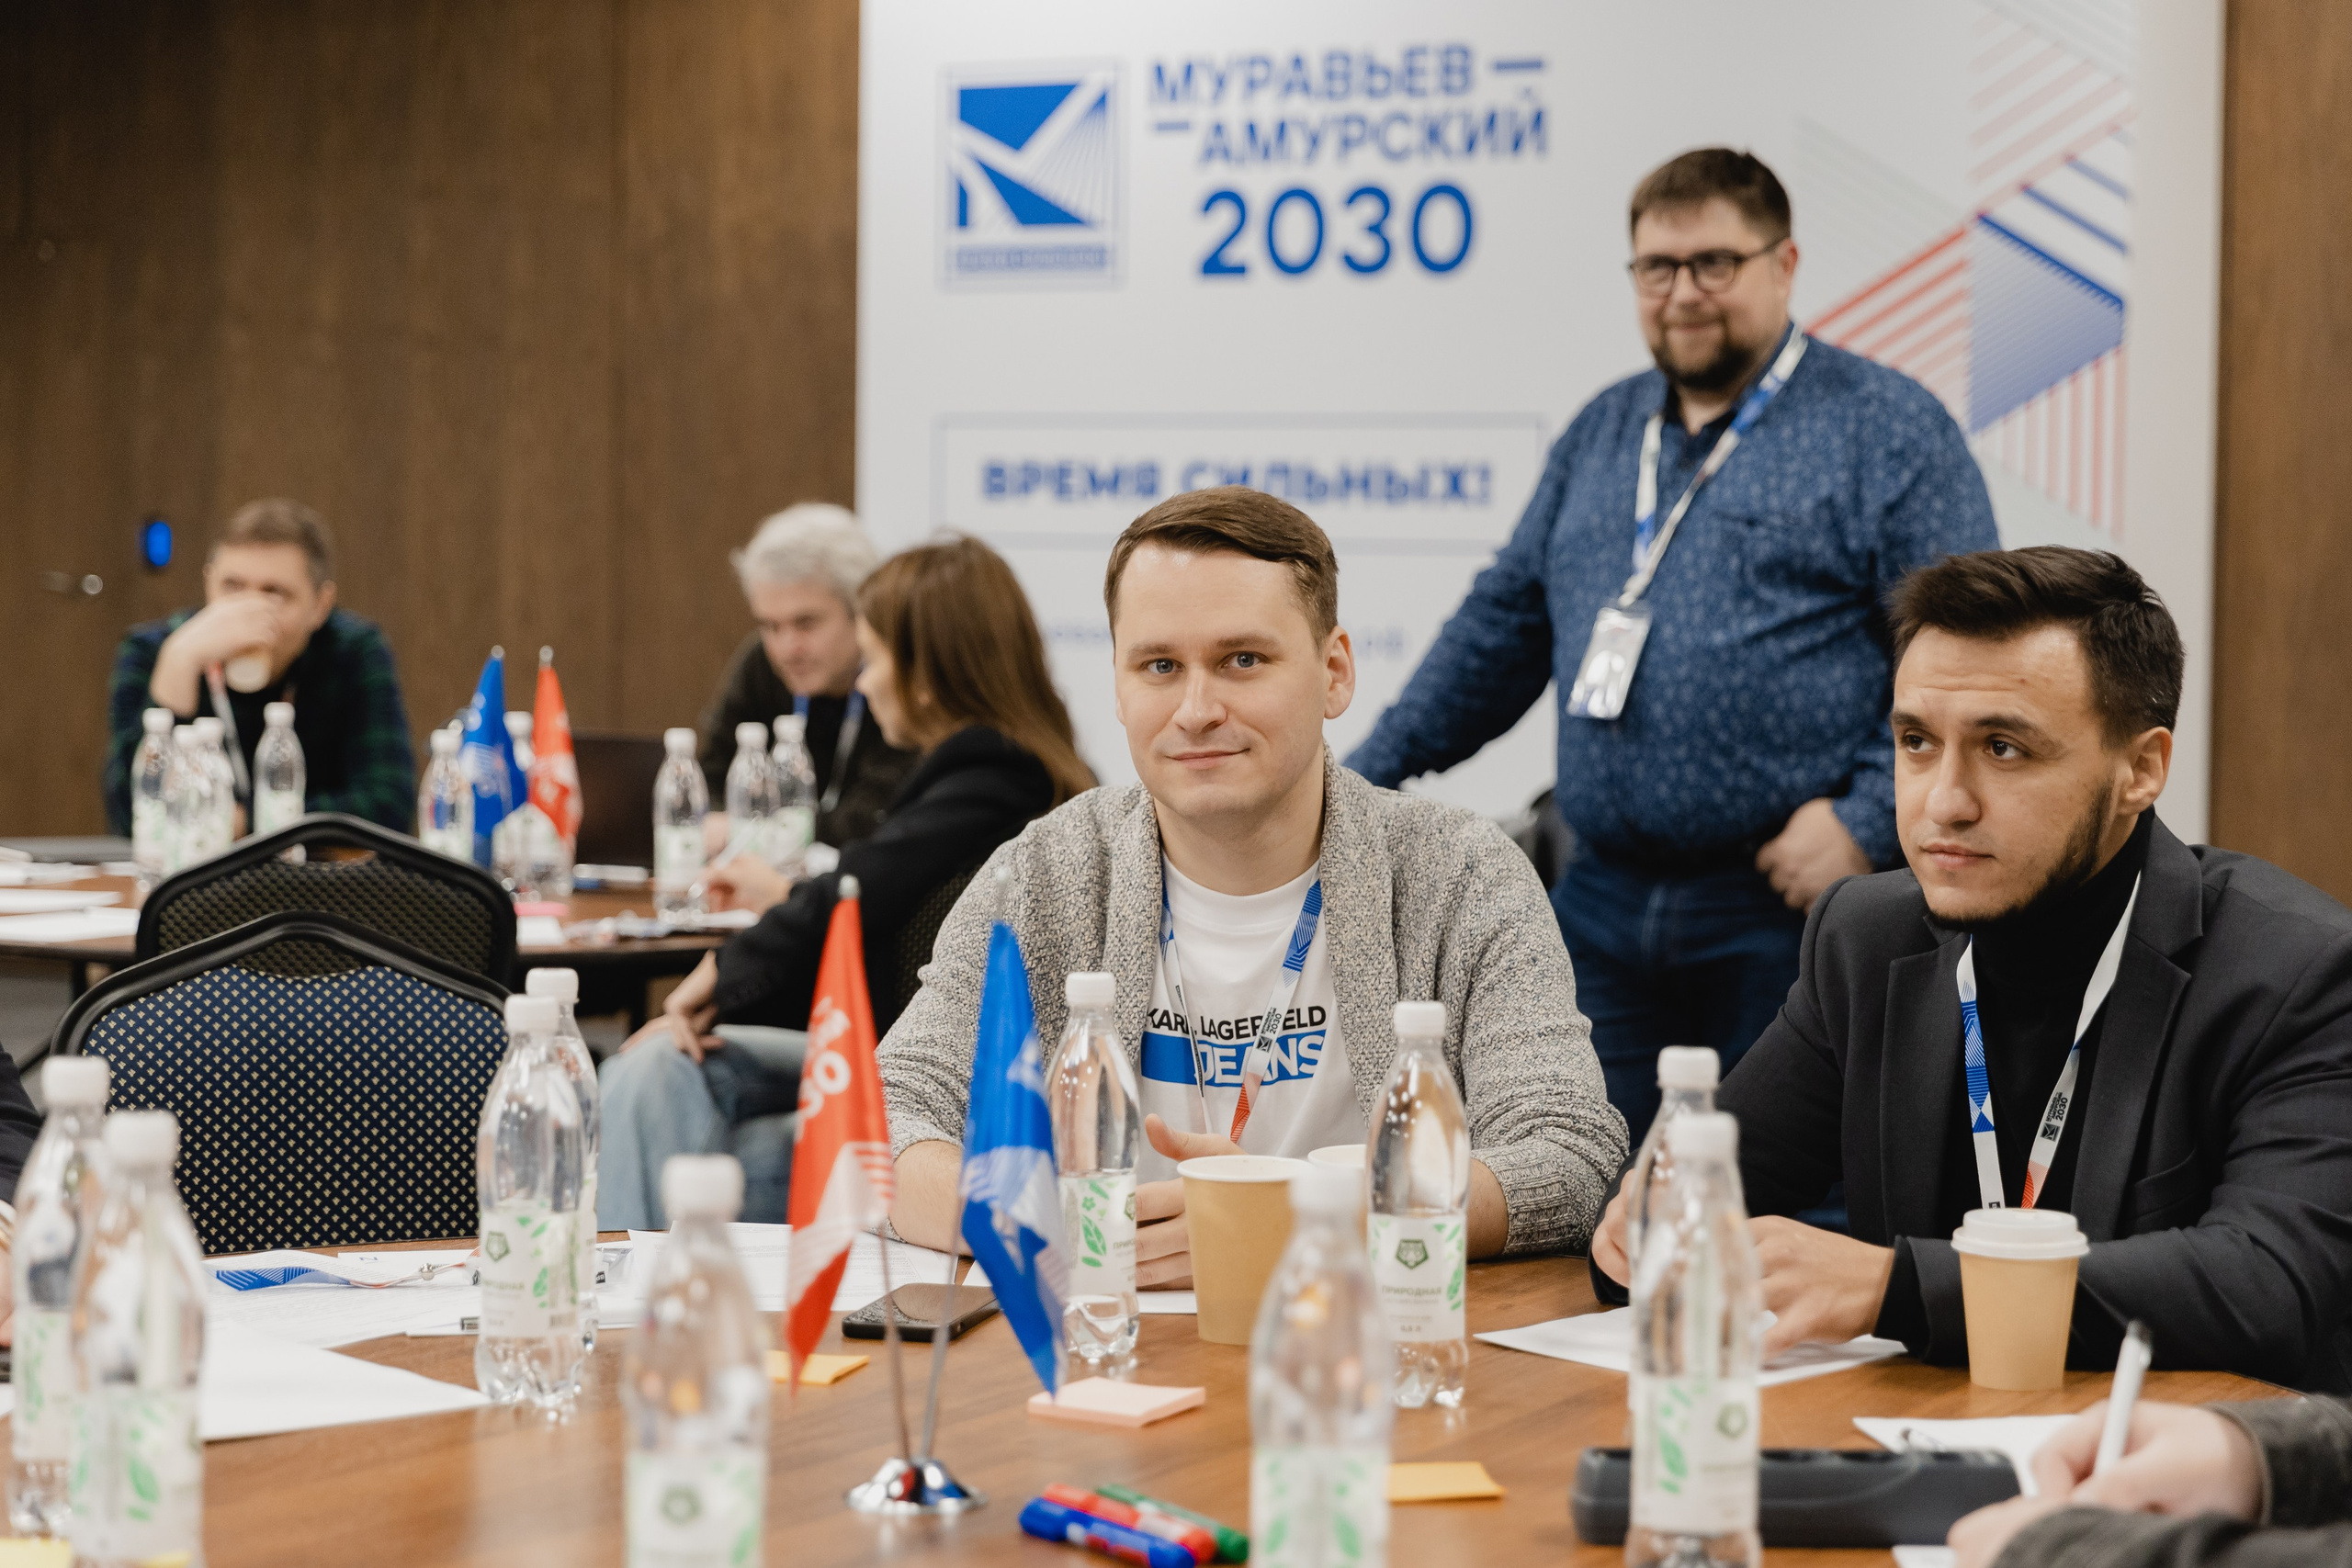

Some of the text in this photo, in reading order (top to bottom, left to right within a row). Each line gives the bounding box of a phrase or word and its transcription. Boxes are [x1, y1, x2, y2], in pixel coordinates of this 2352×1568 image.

[1199, 184, 1472, 276] 2030
[983, 461, 1159, 501] ВРЕМЯ
[1200, 1006, 1326, 1040] LAGERELD
[1270, 1013, 1282, 1034] 2030
[2055, 1097, 2068, 1122] 2030
